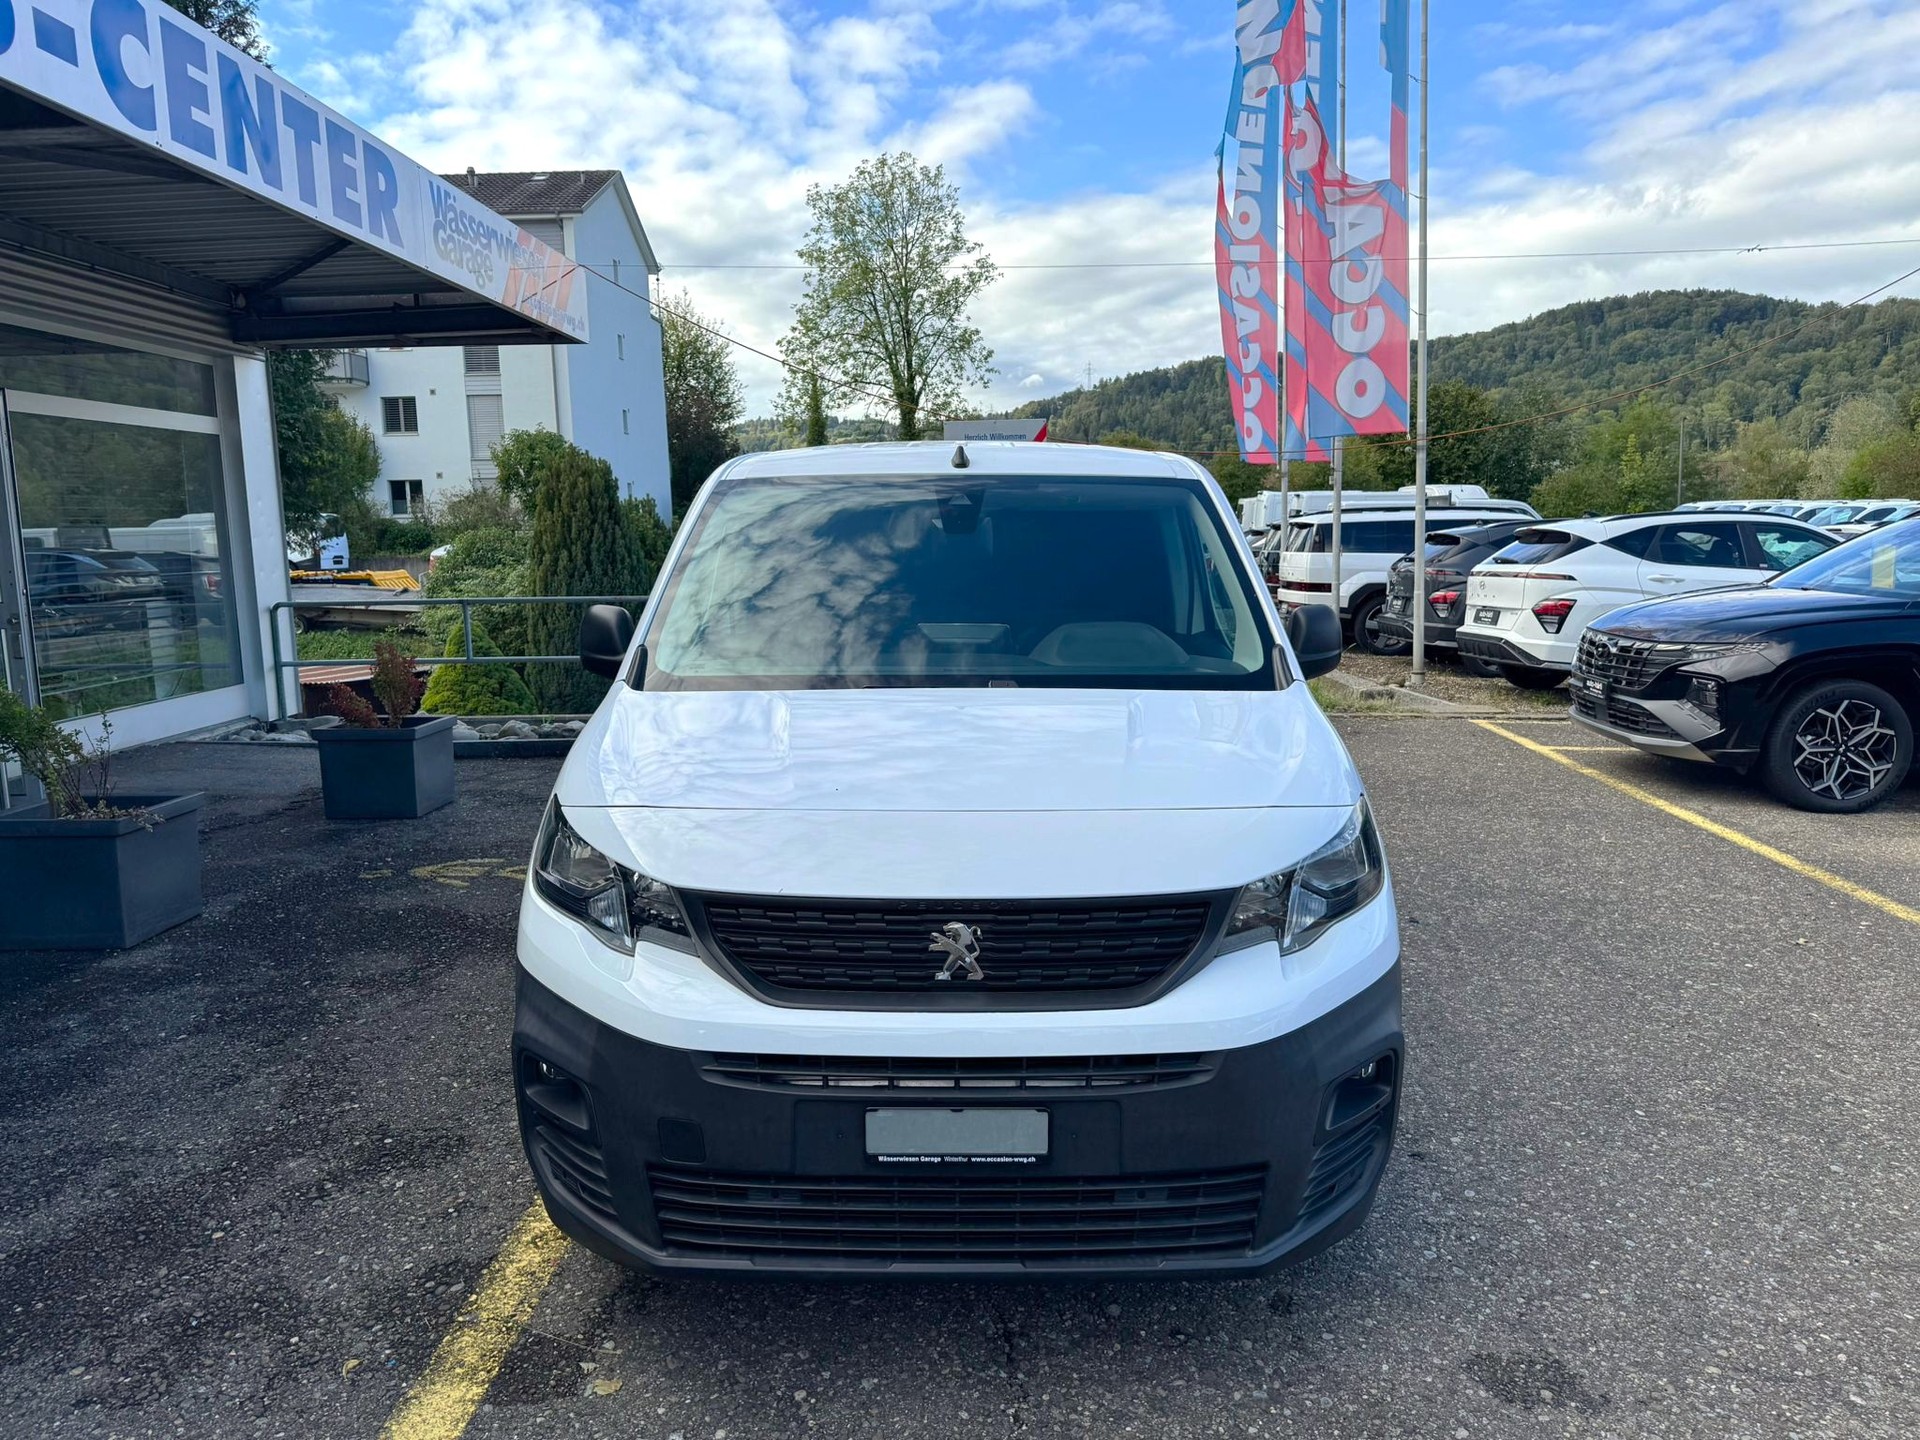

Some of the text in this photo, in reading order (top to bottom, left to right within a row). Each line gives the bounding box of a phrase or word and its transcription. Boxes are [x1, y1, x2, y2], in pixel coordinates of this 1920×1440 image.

[0, 0, 405, 249] -CENTER
[433, 218, 494, 290] Garage
[964, 432, 1027, 441] Herzlich Willkommen
[898, 901, 1017, 910] PEUGEOT
[920, 1155, 941, 1163] Garage
